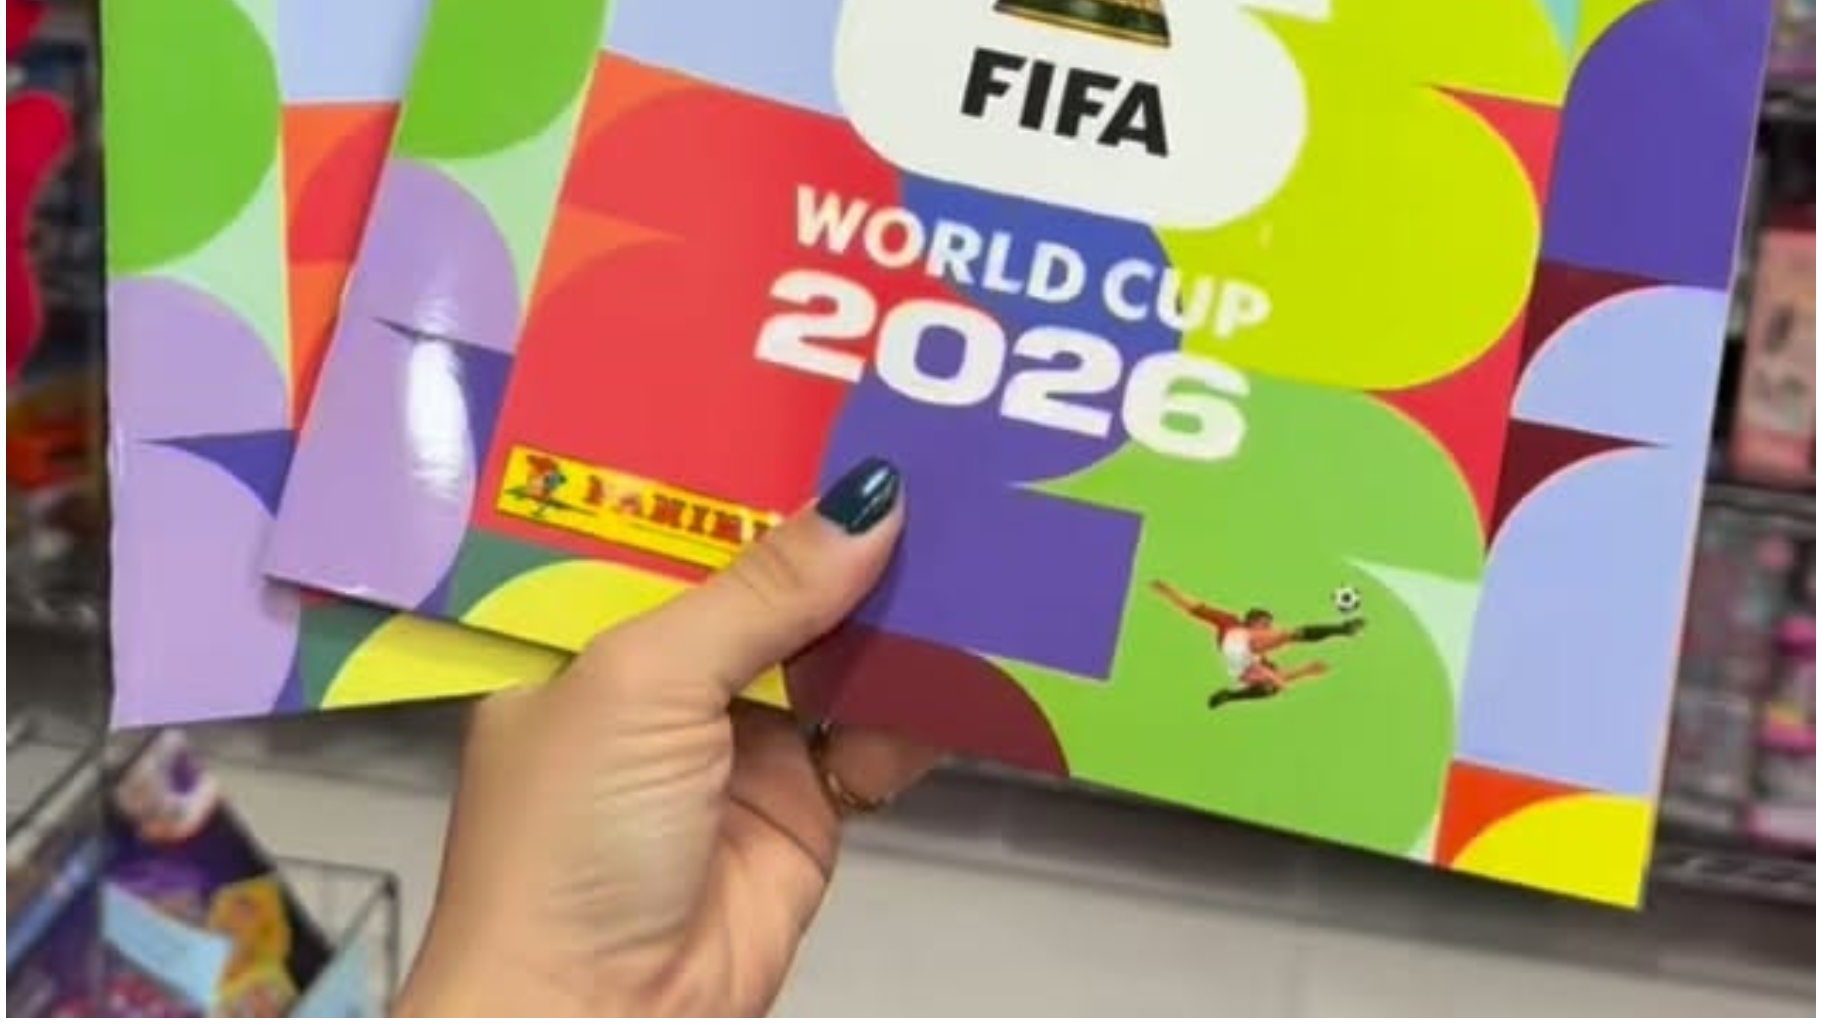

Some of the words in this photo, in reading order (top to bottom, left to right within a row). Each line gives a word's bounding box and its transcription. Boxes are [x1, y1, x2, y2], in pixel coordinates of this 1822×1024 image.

[960, 46, 1168, 158] FIFA
[798, 184, 1086, 304] WORLD
[1102, 258, 1272, 339] CUP
[753, 269, 1252, 462] 2026
